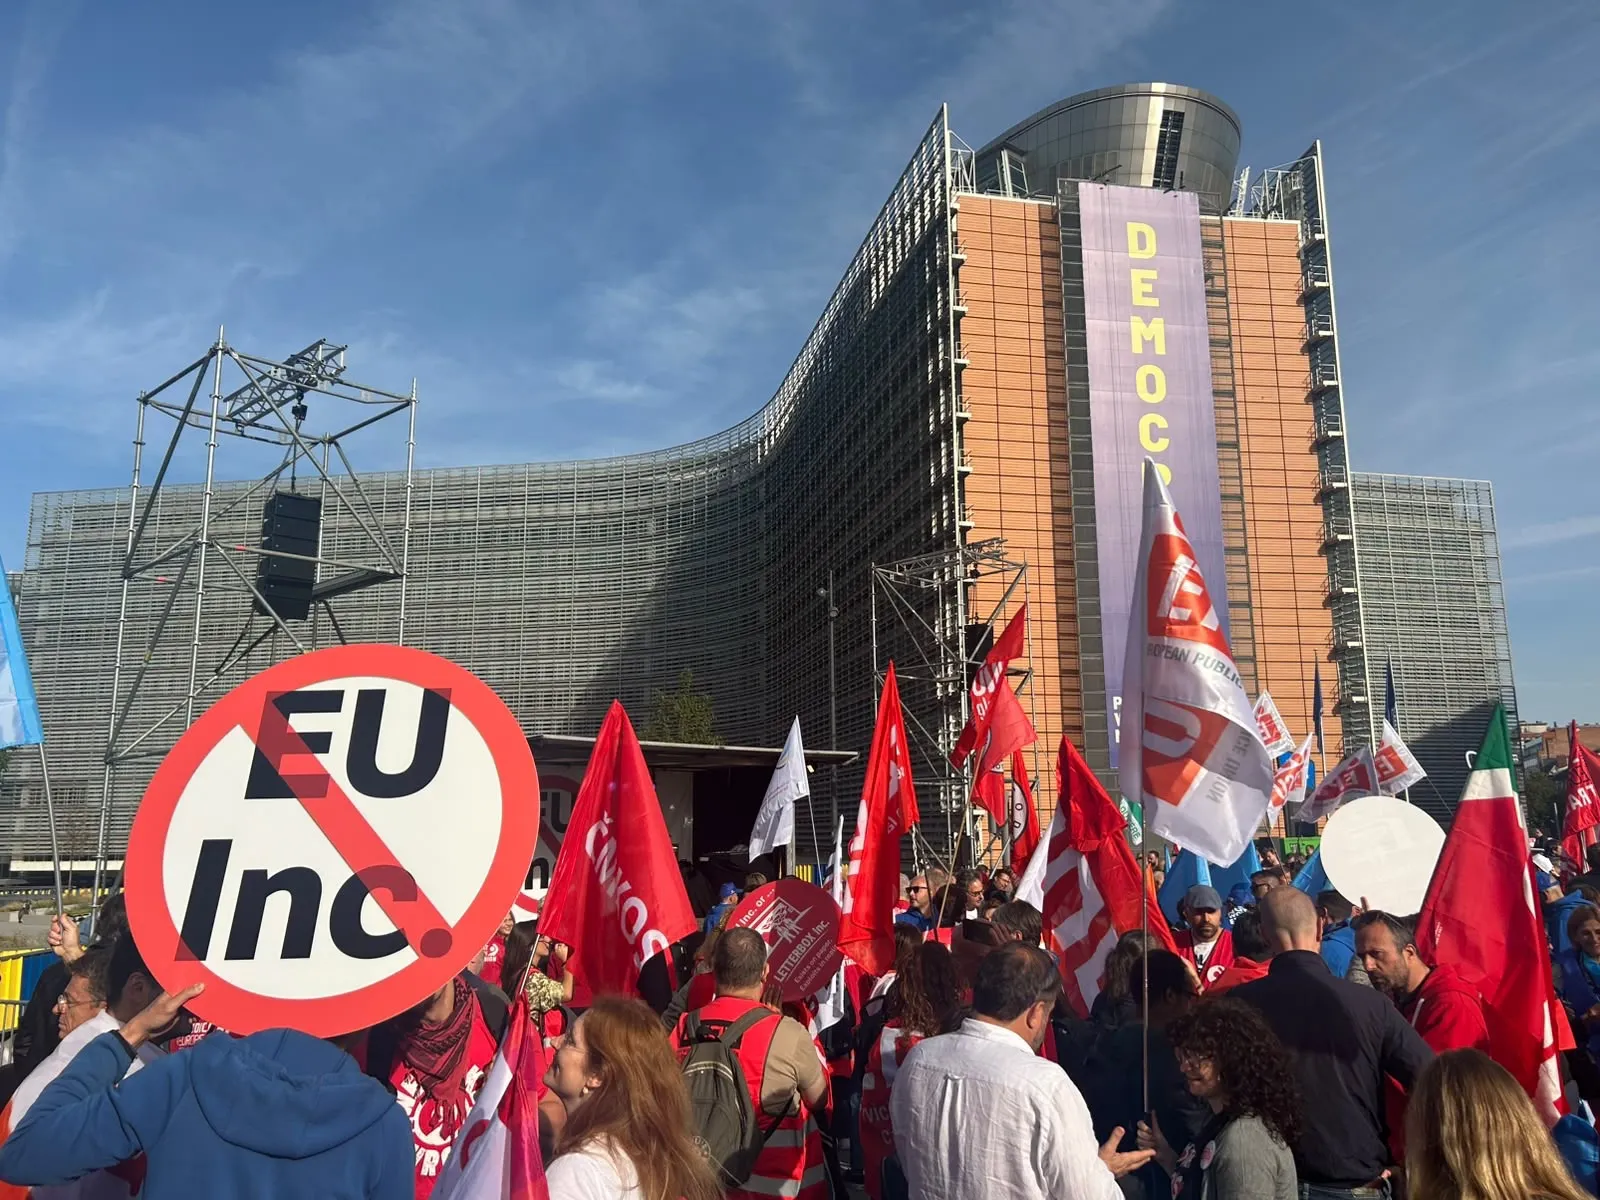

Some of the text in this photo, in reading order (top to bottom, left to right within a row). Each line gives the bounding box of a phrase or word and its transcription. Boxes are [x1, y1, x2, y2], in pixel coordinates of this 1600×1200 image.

[244, 688, 452, 800] EU
[174, 838, 453, 962] Inc.
[739, 907, 757, 925] Inc.
[755, 895, 766, 908] or
[774, 920, 830, 982] LETTERBOX Inc.
